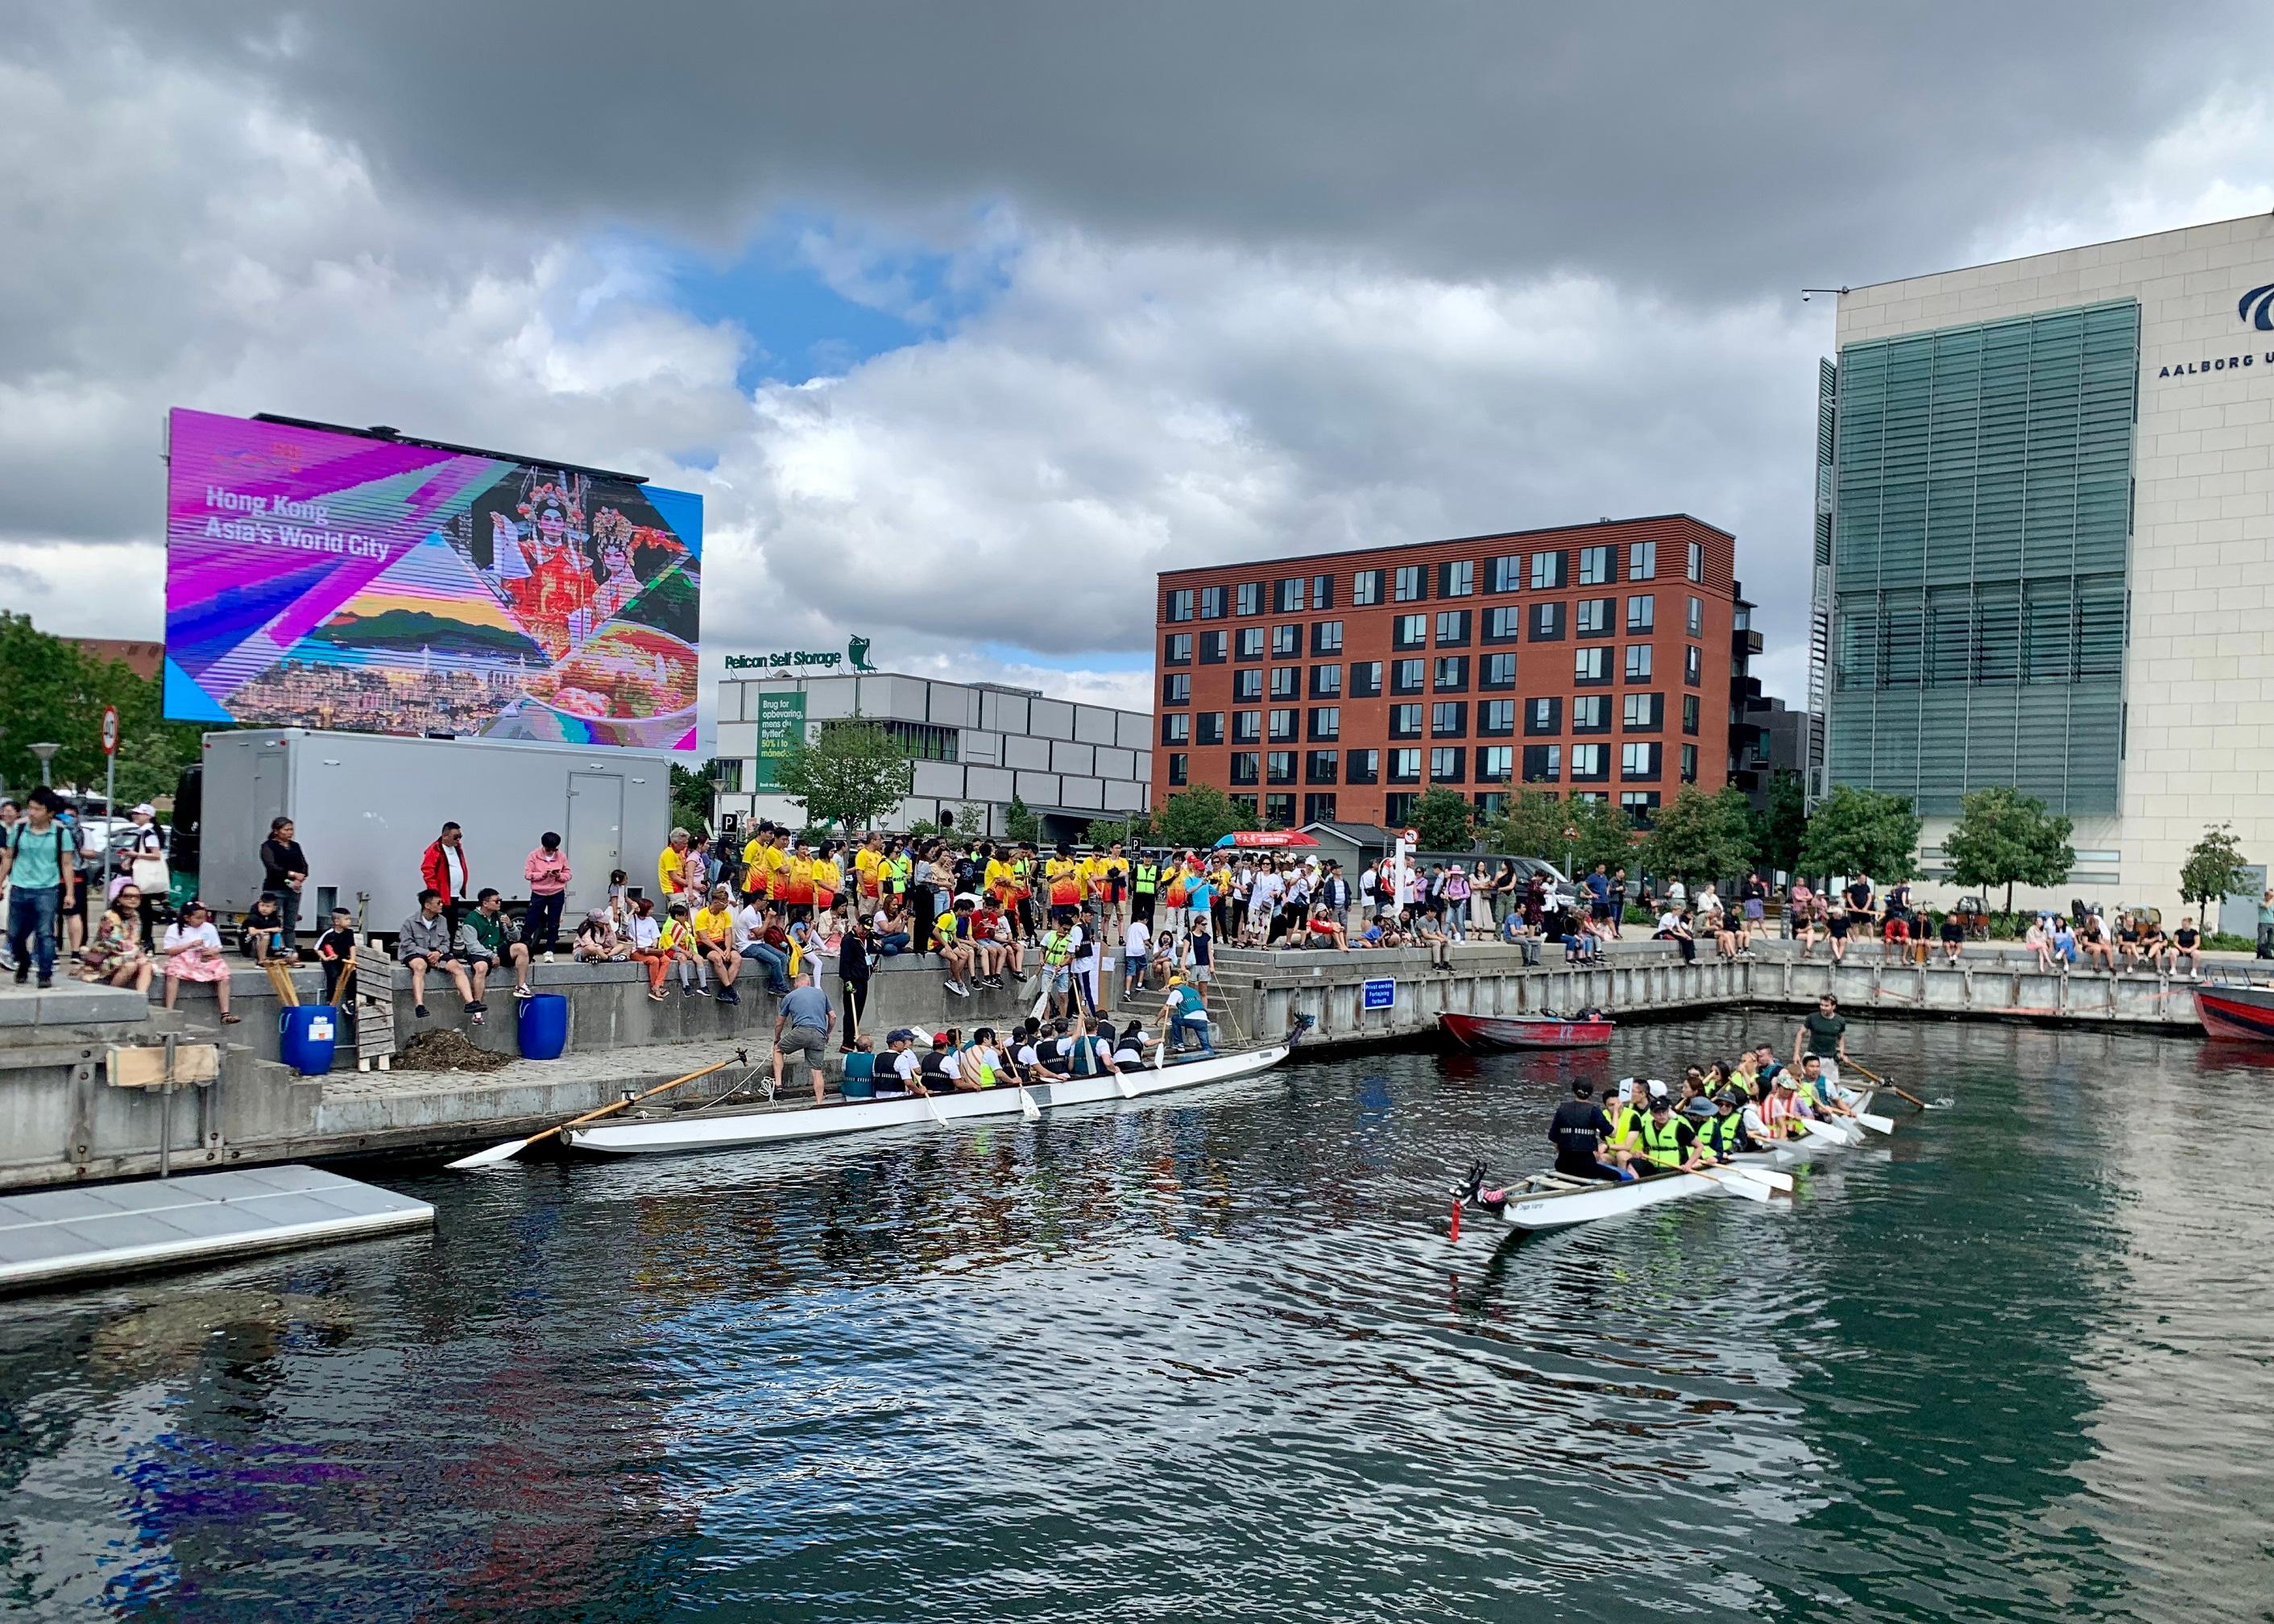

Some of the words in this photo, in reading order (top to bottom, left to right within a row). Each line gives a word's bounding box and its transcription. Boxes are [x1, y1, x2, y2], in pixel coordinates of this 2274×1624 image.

[2159, 354, 2253, 378] AALBORG
[205, 484, 268, 517] Hong
[272, 494, 329, 525] Kong
[204, 516, 273, 544] Asia's
[278, 525, 343, 553] World
[348, 534, 391, 562] City
[725, 654, 767, 669] Pelican
[770, 652, 792, 667] Self
[794, 651, 842, 668] Storage
[763, 700, 778, 710] Brug
[780, 699, 789, 708] for
[762, 710, 803, 719] opbevaring,
[782, 719, 792, 728] du
[761, 740, 776, 748] 50%
[725, 816, 733, 830] P
[1133, 839, 1138, 850] P
